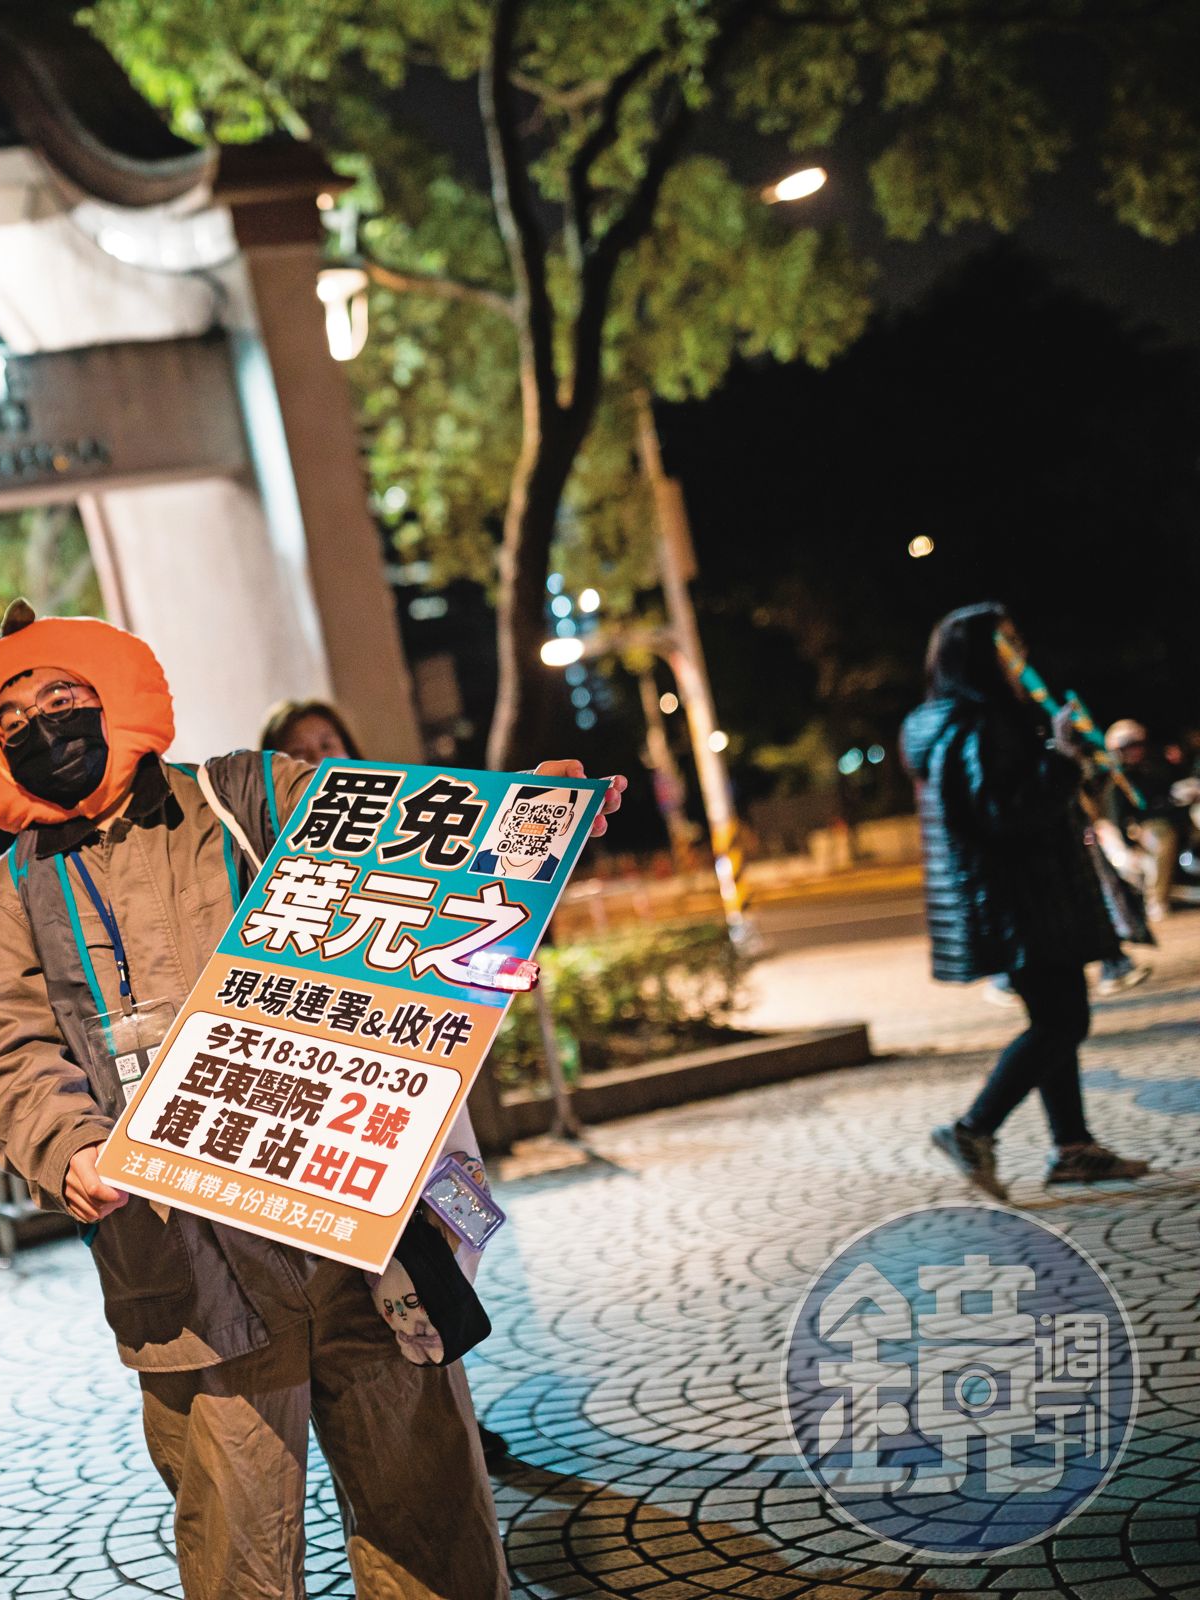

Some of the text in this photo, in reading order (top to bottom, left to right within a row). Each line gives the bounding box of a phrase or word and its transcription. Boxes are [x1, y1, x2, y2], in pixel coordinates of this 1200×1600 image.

[289, 769, 486, 868] 罷免
[240, 857, 531, 990] 葉元之
[217, 968, 473, 1056] 現場連署&收件
[178, 1051, 333, 1127] 亞東醫院
[206, 1021, 429, 1098] 今天18:30-20:30
[150, 1094, 388, 1203] 捷運站 出口
